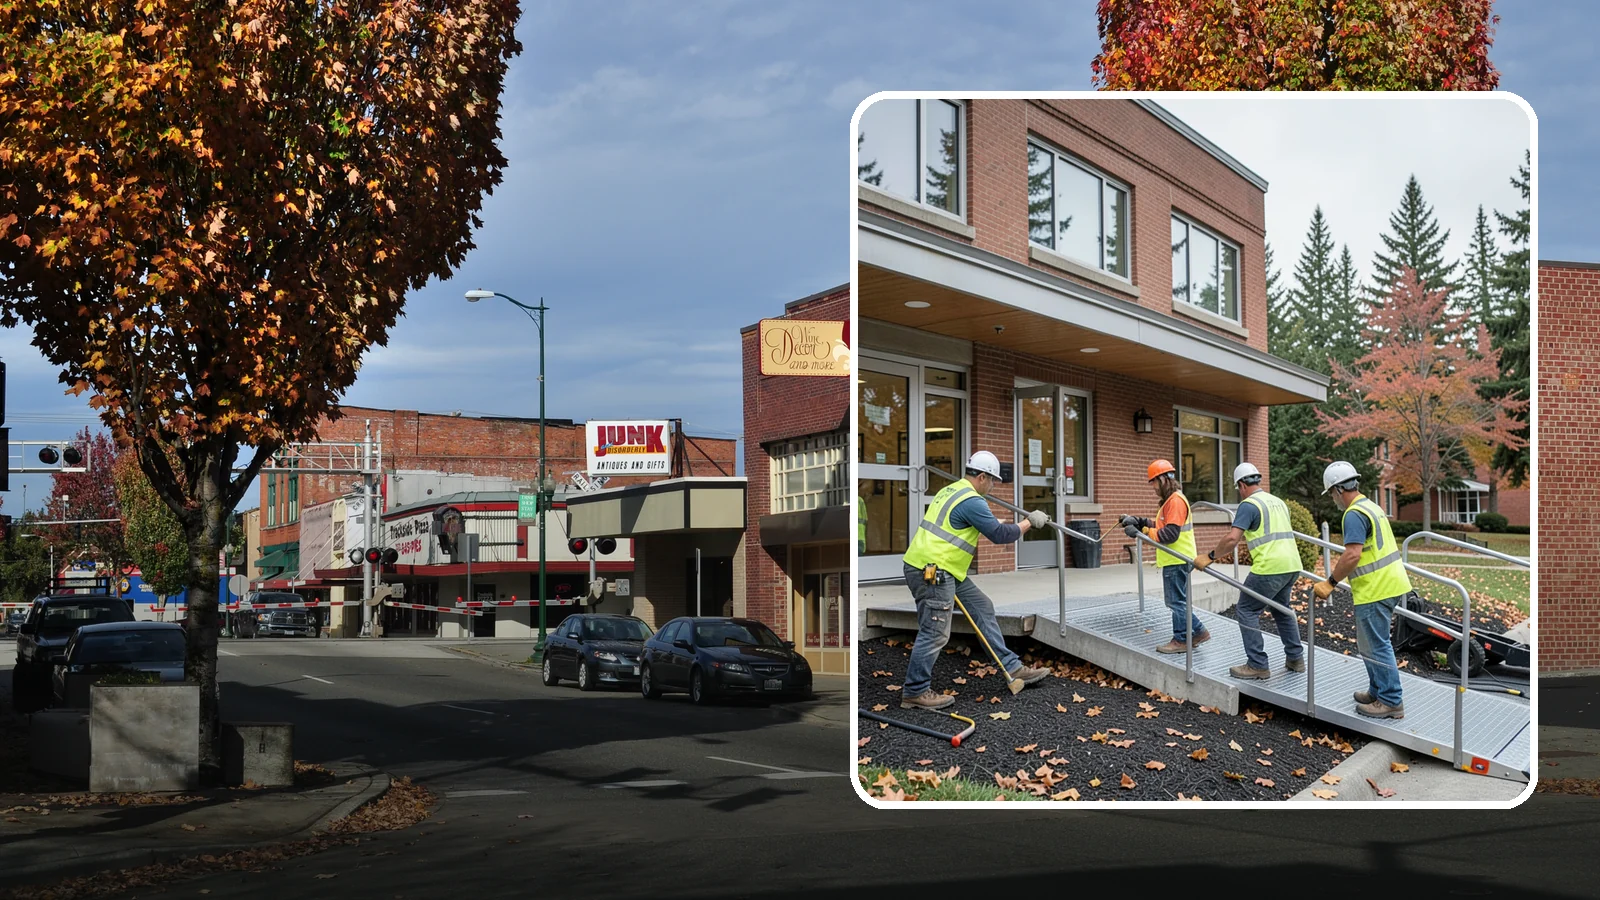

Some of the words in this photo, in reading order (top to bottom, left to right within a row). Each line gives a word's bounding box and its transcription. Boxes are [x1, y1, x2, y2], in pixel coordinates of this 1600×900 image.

[765, 328, 830, 365] Decor
[596, 425, 665, 457] JUNK
[631, 461, 643, 469] AND
[647, 461, 665, 469] GIFTS
